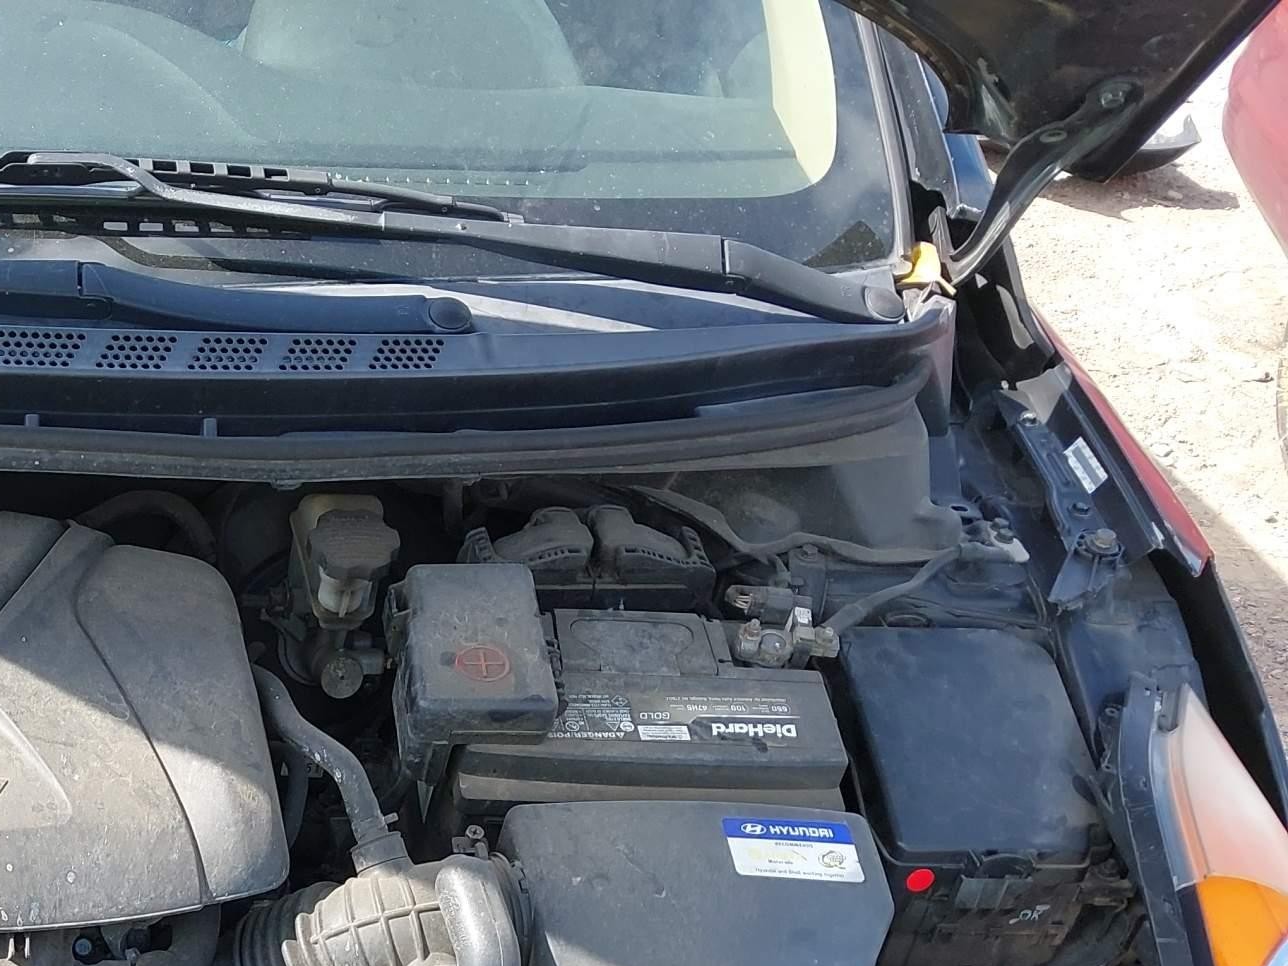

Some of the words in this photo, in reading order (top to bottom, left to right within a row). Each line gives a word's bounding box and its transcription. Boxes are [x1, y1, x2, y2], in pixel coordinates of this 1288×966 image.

[639, 711, 671, 720] GOLD
[711, 723, 798, 738] DieHard
[769, 825, 834, 838] HYUNDAI
